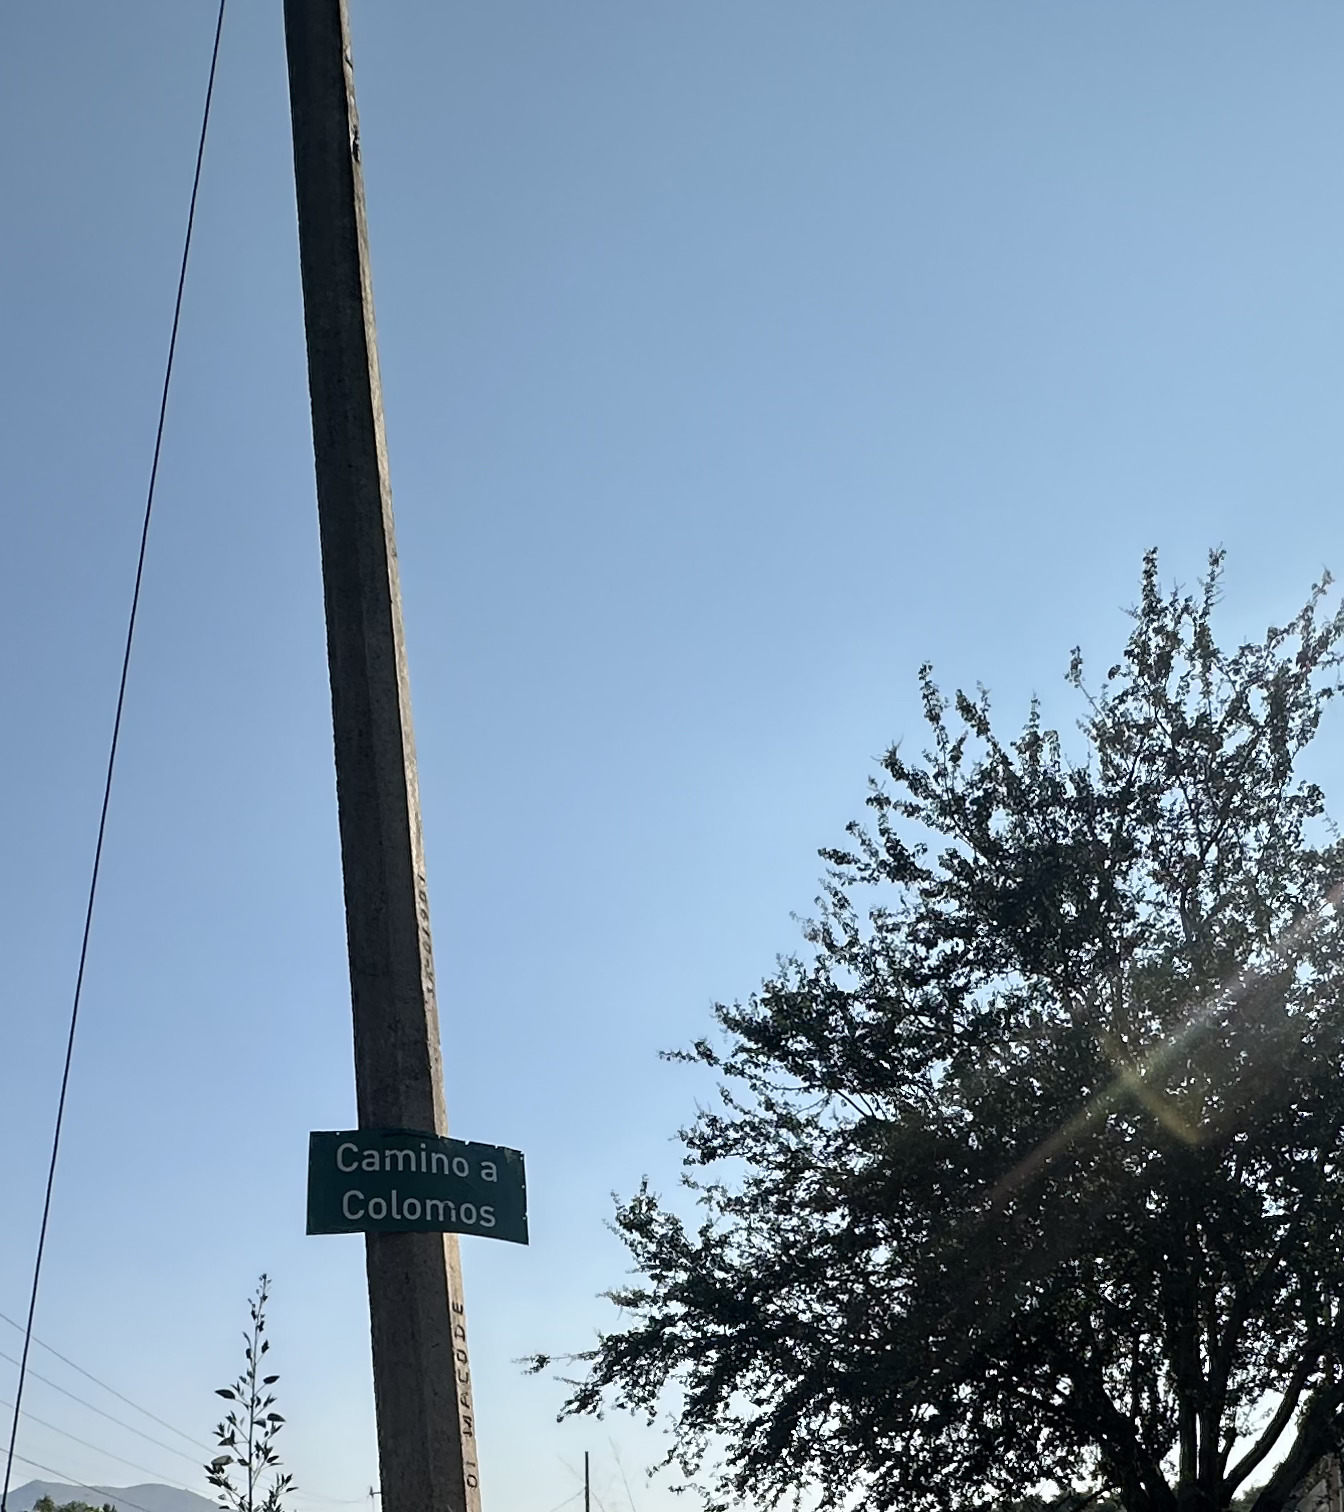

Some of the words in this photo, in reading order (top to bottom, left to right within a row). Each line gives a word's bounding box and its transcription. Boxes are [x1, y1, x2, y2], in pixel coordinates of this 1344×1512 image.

[336, 1142, 469, 1178] Camino
[480, 1160, 498, 1183] a
[342, 1189, 496, 1227] Colomos
